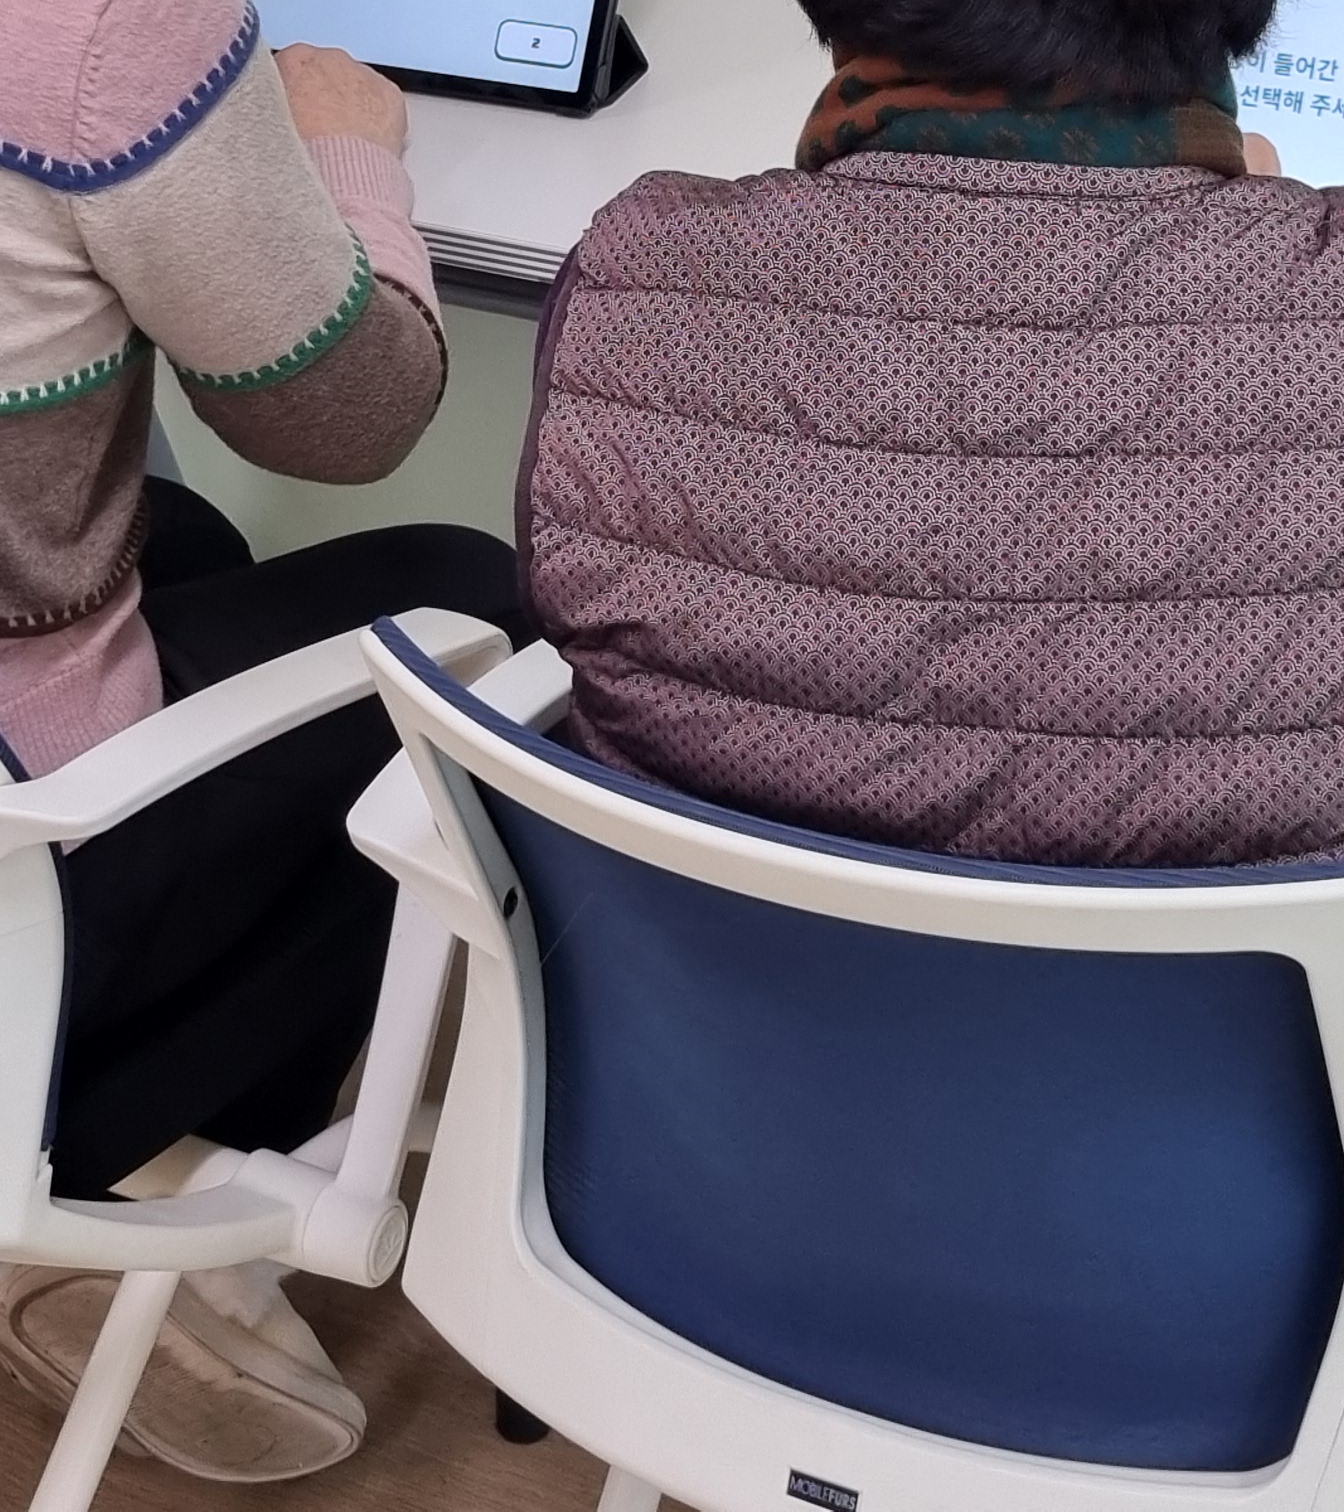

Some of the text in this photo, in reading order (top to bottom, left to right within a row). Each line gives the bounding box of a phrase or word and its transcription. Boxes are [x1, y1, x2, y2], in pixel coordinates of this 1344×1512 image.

[530, 37, 541, 49] 2
[1273, 52, 1339, 82] 들어간
[1240, 85, 1304, 114] 선택해
